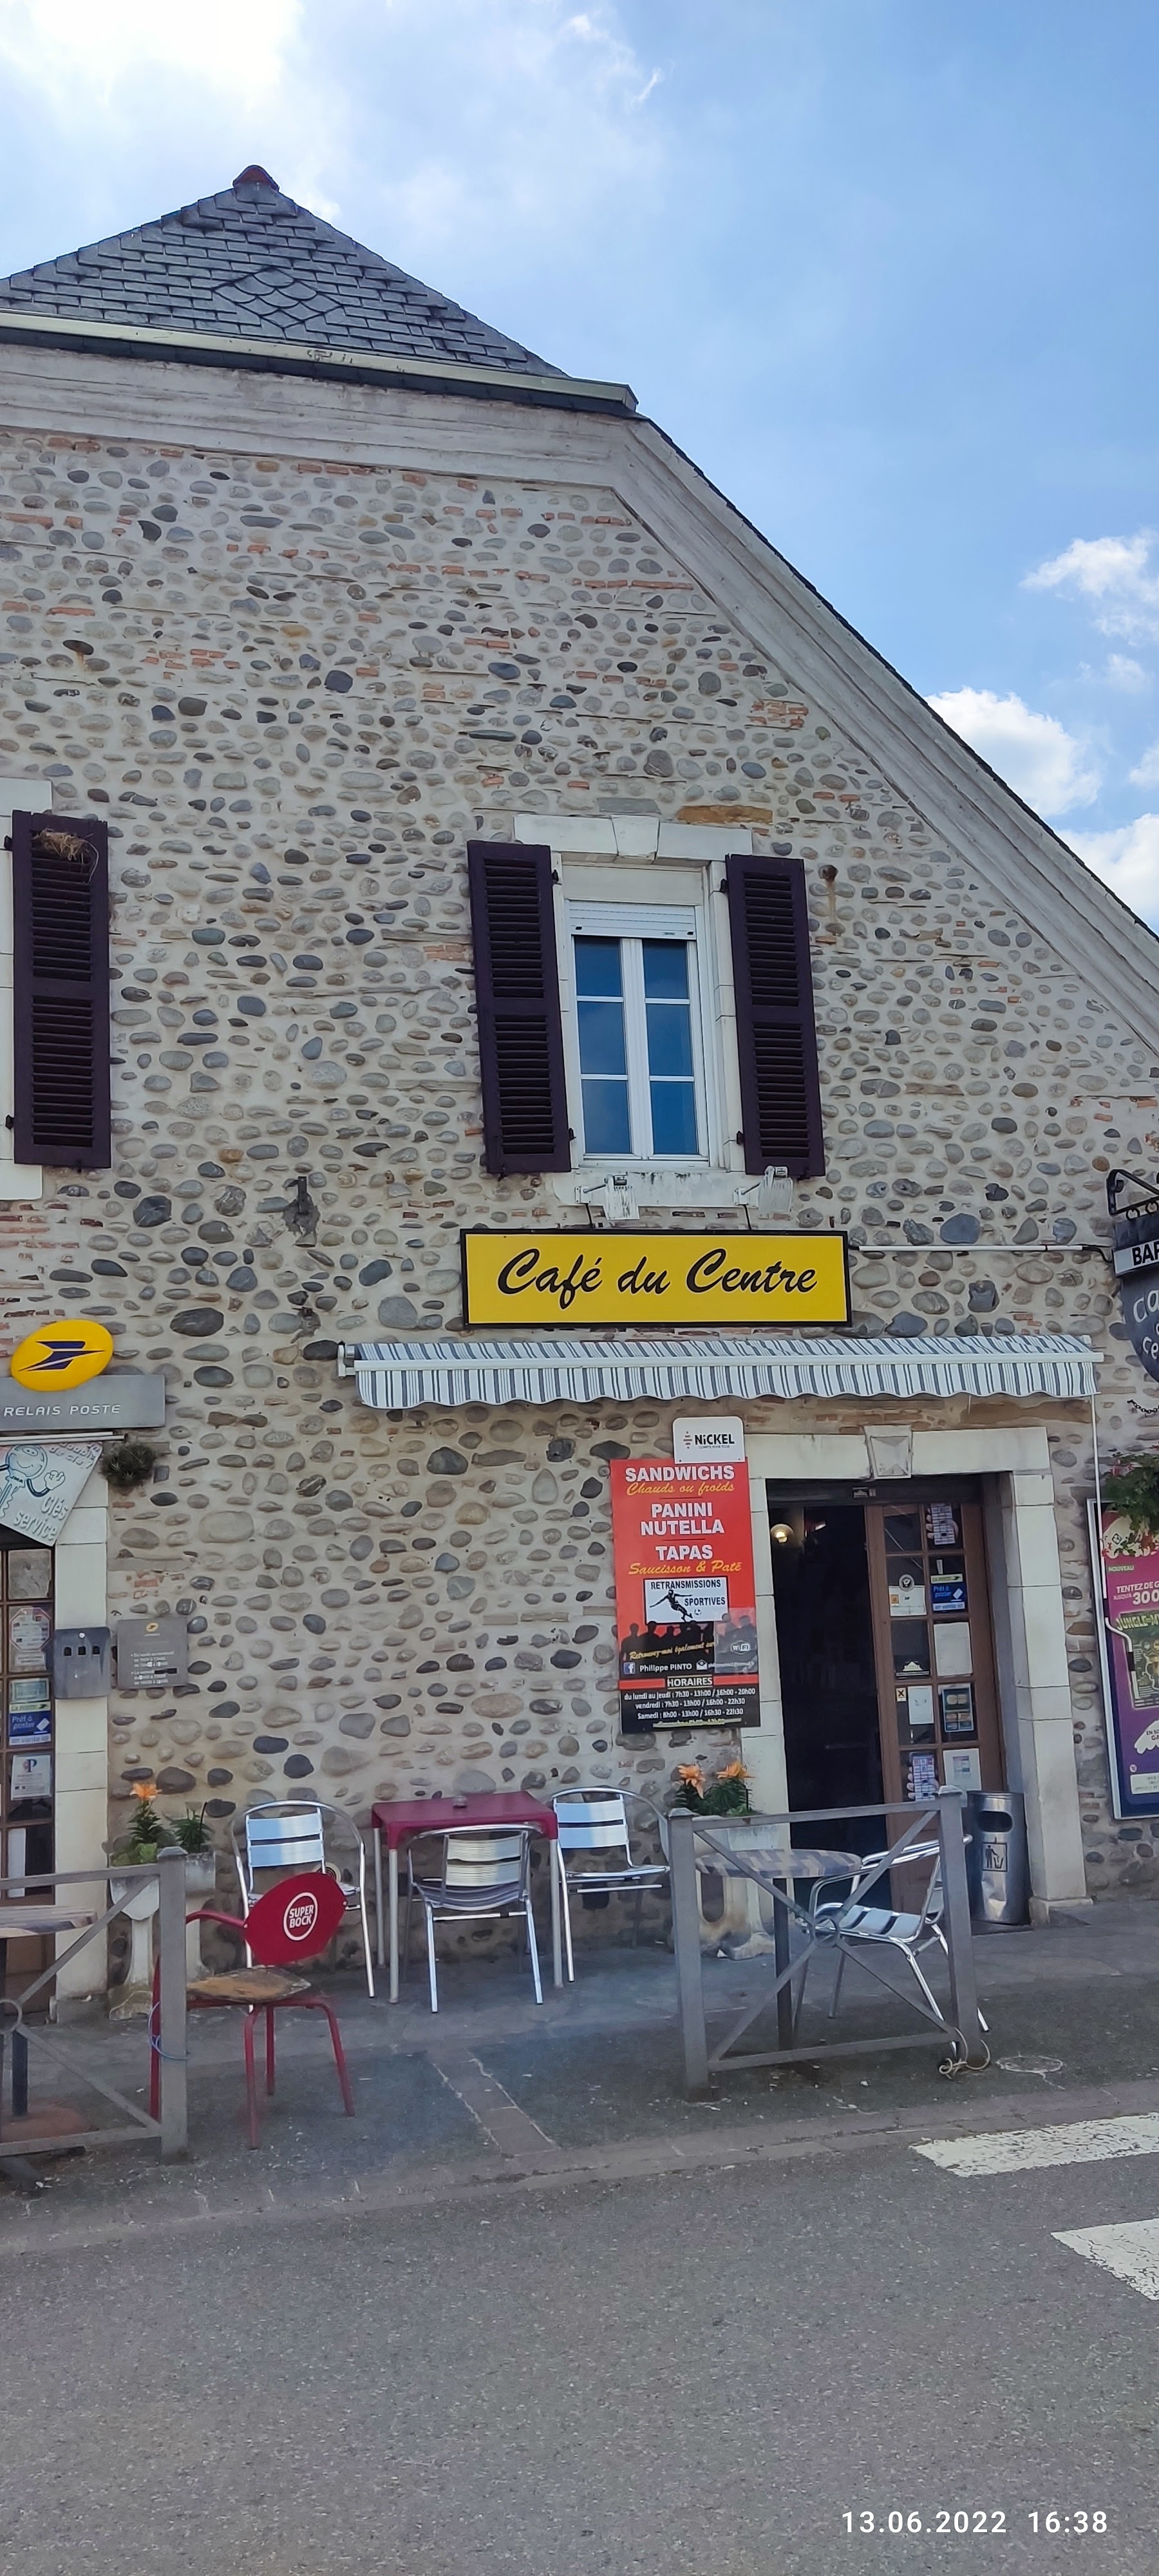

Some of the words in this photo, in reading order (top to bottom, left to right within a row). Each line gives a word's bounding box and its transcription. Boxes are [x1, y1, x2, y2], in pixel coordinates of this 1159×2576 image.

[498, 1248, 602, 1310] Café
[617, 1256, 670, 1294] du
[686, 1248, 817, 1294] Centre
[4, 1406, 61, 1417] RELAIS
[70, 1405, 121, 1415] POSTE
[625, 1466, 735, 1481] SANDWICHS
[627, 1482, 675, 1496] Chauds
[698, 1481, 735, 1495] froids
[651, 1502, 713, 1518] PANINI
[14, 1512, 57, 1541] service
[641, 1519, 724, 1535] NUTELLA
[655, 1545, 713, 1560] TAPAS
[628, 1562, 691, 1575] Saucisson
[696, 1561, 706, 1572] &
[650, 1580, 721, 1589] RETRANSMISSIONS
[1117, 1583, 1144, 1593] TENTEZ
[684, 1597, 726, 1606] SPORTIVES
[639, 1663, 668, 1673] Philippe
[670, 1663, 692, 1671] PINTO
[667, 1677, 713, 1688] HORAIRES
[656, 1691, 671, 1700] jeudi
[289, 1904, 314, 1918] SUPER
[289, 1915, 312, 1929] BOCK
